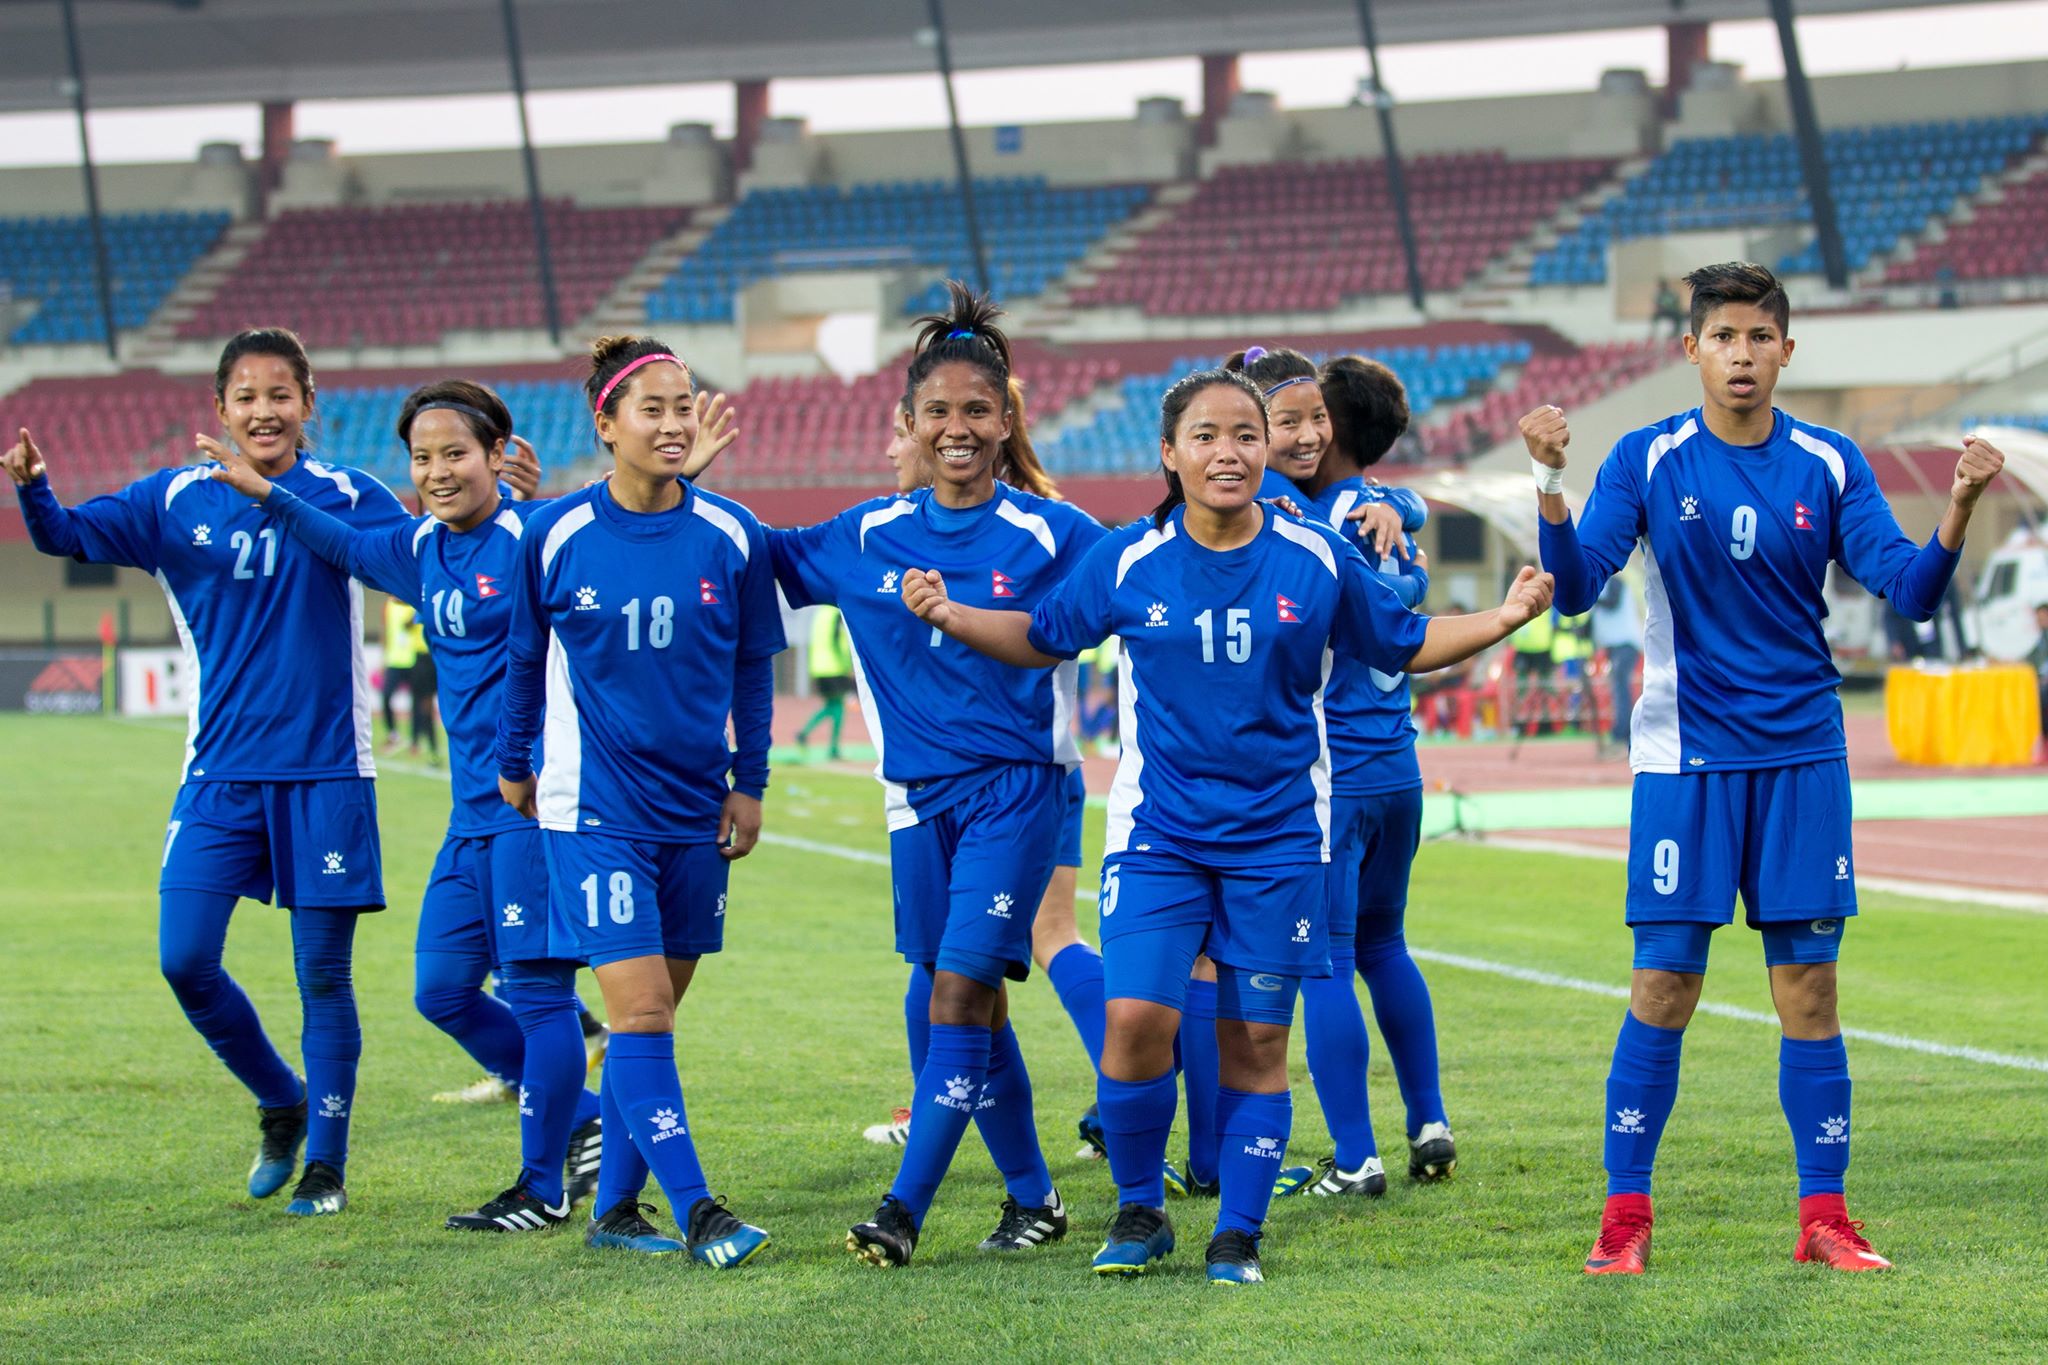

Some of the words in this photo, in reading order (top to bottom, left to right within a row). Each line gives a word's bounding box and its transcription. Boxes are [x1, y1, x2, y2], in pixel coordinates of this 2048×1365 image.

[1730, 505, 1757, 560] 9
[230, 528, 277, 580] 21
[432, 588, 466, 638] 19
[621, 595, 674, 651] 18
[1194, 608, 1252, 663] 15
[1653, 838, 1680, 895] 9
[580, 871, 635, 928] 18
[987, 908, 1012, 919] KELME
[318, 1109, 347, 1118] KELME
[934, 1094, 972, 1112] KELME
[651, 1127, 686, 1144] KELME
[1611, 1123, 1645, 1134] KELME
[1815, 1135, 1848, 1144] KELME
[1244, 1145, 1282, 1160] KELME
